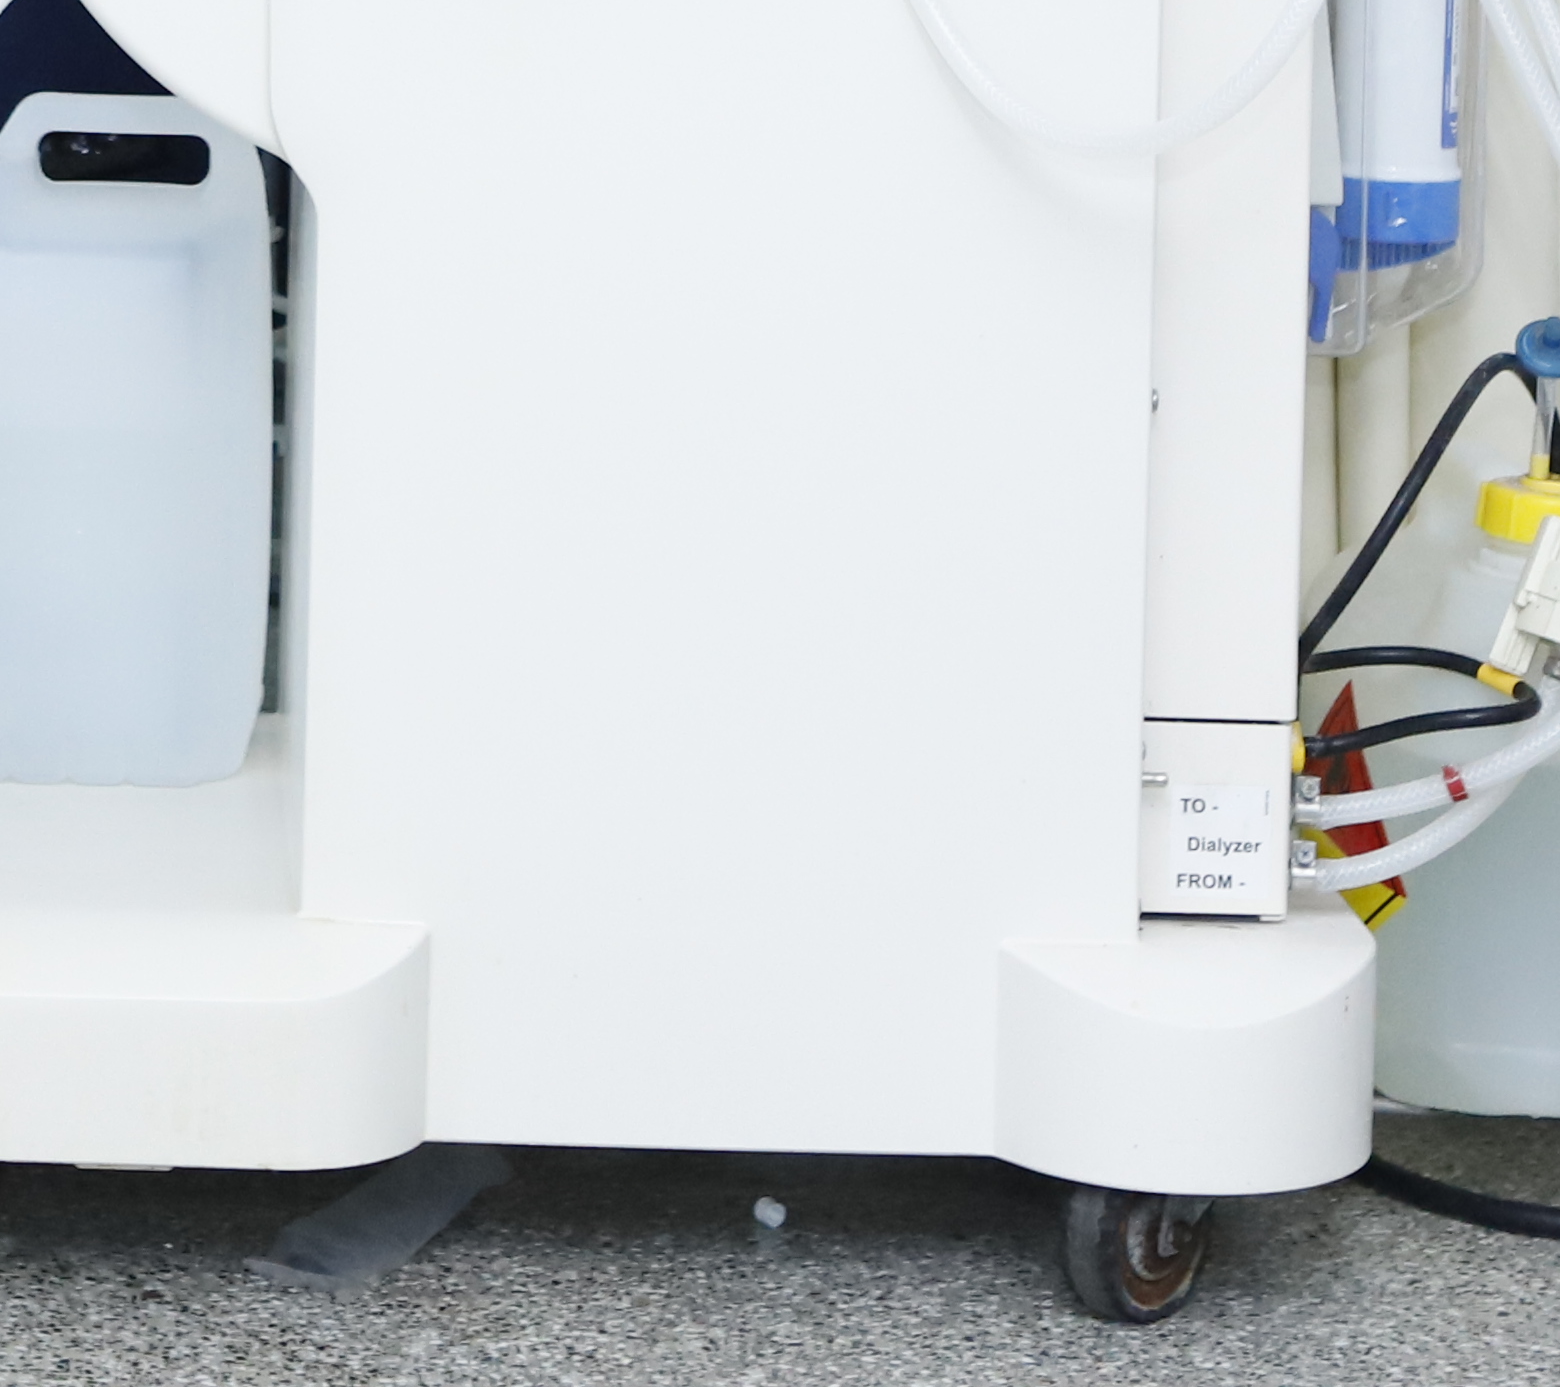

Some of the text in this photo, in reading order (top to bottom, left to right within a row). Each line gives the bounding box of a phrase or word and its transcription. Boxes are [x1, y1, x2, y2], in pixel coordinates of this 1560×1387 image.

[1180, 797, 1206, 814] TO
[1187, 836, 1262, 856] Dialyzer
[1176, 873, 1233, 890] FROM
